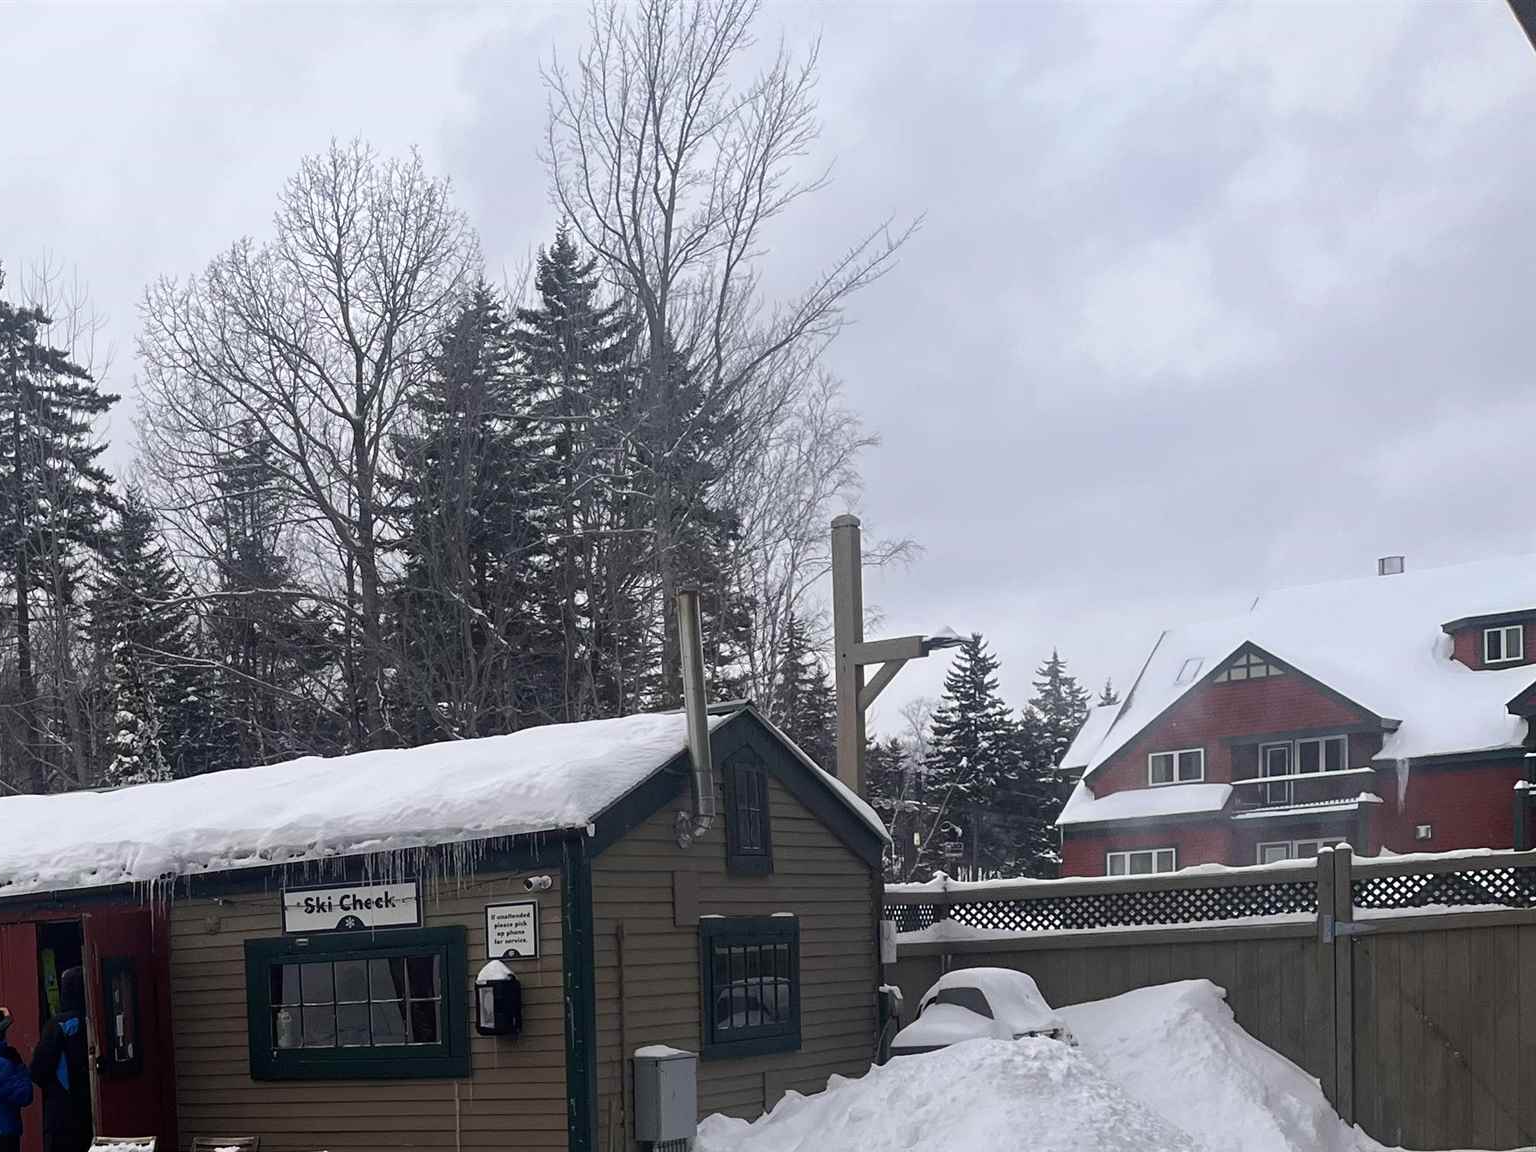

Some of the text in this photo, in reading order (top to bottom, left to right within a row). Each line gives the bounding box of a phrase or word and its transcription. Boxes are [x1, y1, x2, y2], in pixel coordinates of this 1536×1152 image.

[304, 891, 396, 914] Ski Check
[496, 912, 530, 920] unattended
[494, 920, 527, 930] please pick
[506, 929, 525, 937] phone
